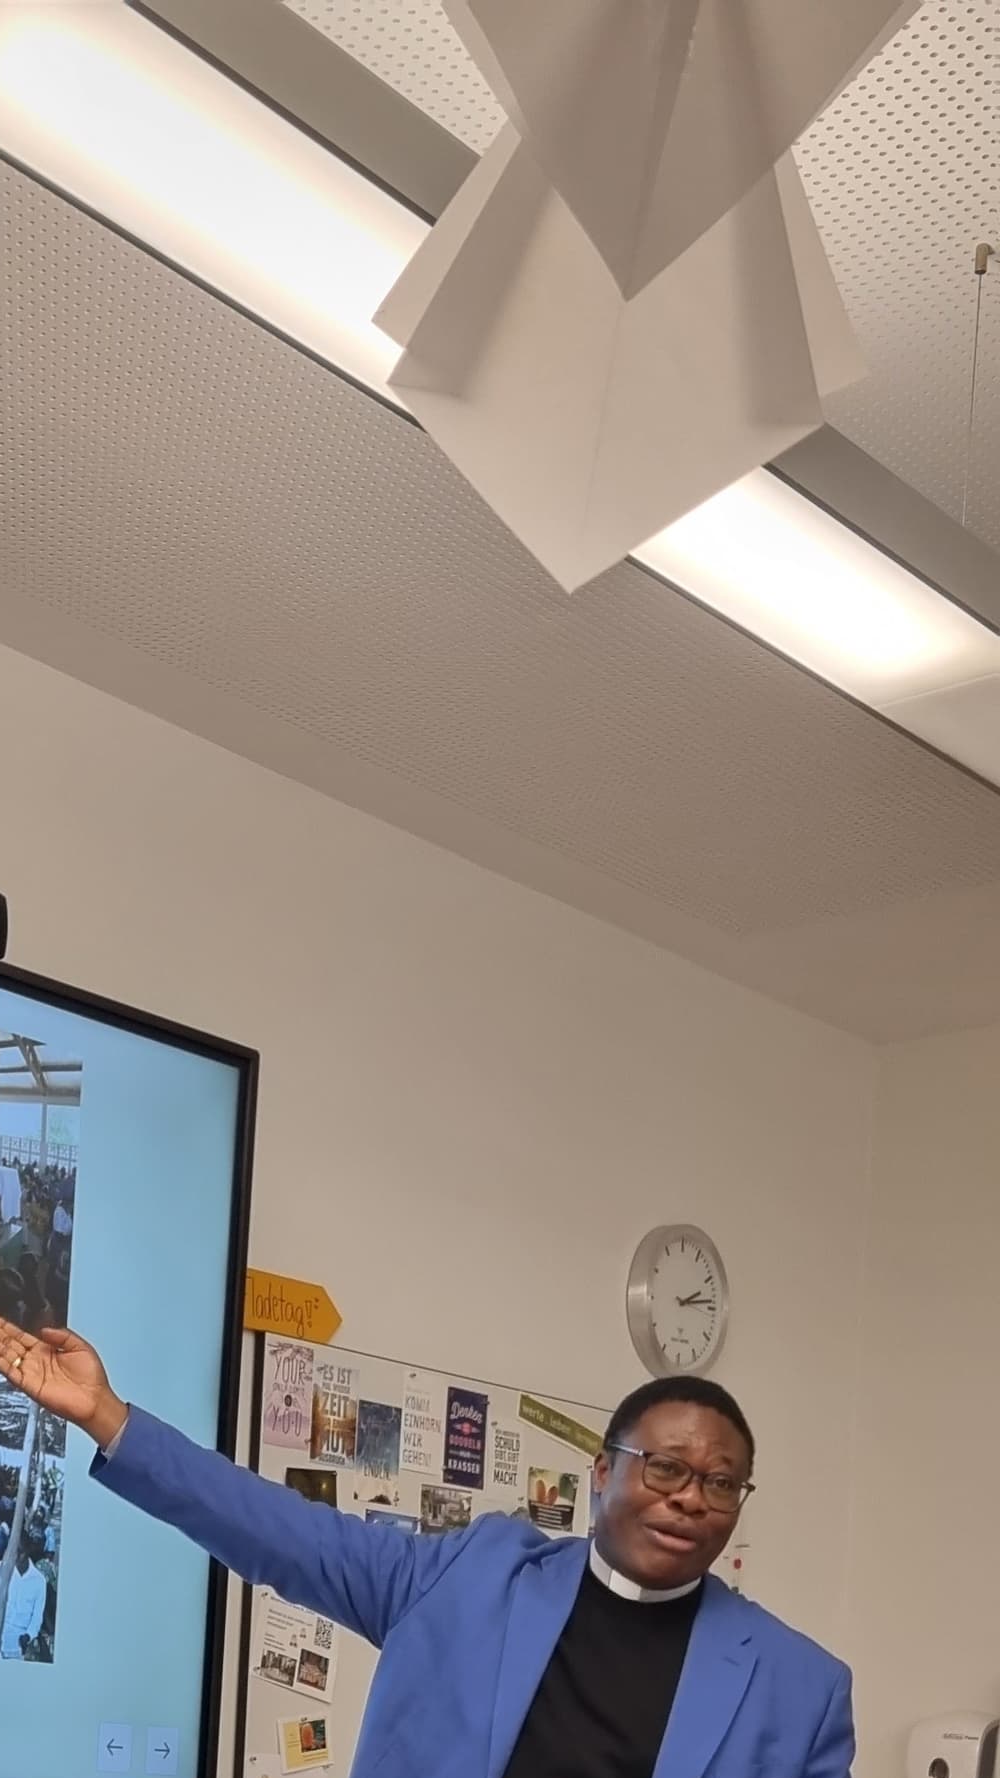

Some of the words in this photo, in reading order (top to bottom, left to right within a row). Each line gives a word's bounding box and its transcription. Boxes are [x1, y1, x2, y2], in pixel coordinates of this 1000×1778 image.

[273, 1353, 306, 1385] YOUR
[322, 1364, 334, 1381] ES
[336, 1367, 352, 1385] IST
[321, 1392, 350, 1419] ZEIT
[450, 1401, 483, 1424] Denken
[403, 1431, 423, 1448] WIR
[447, 1459, 480, 1474] KRASSER
